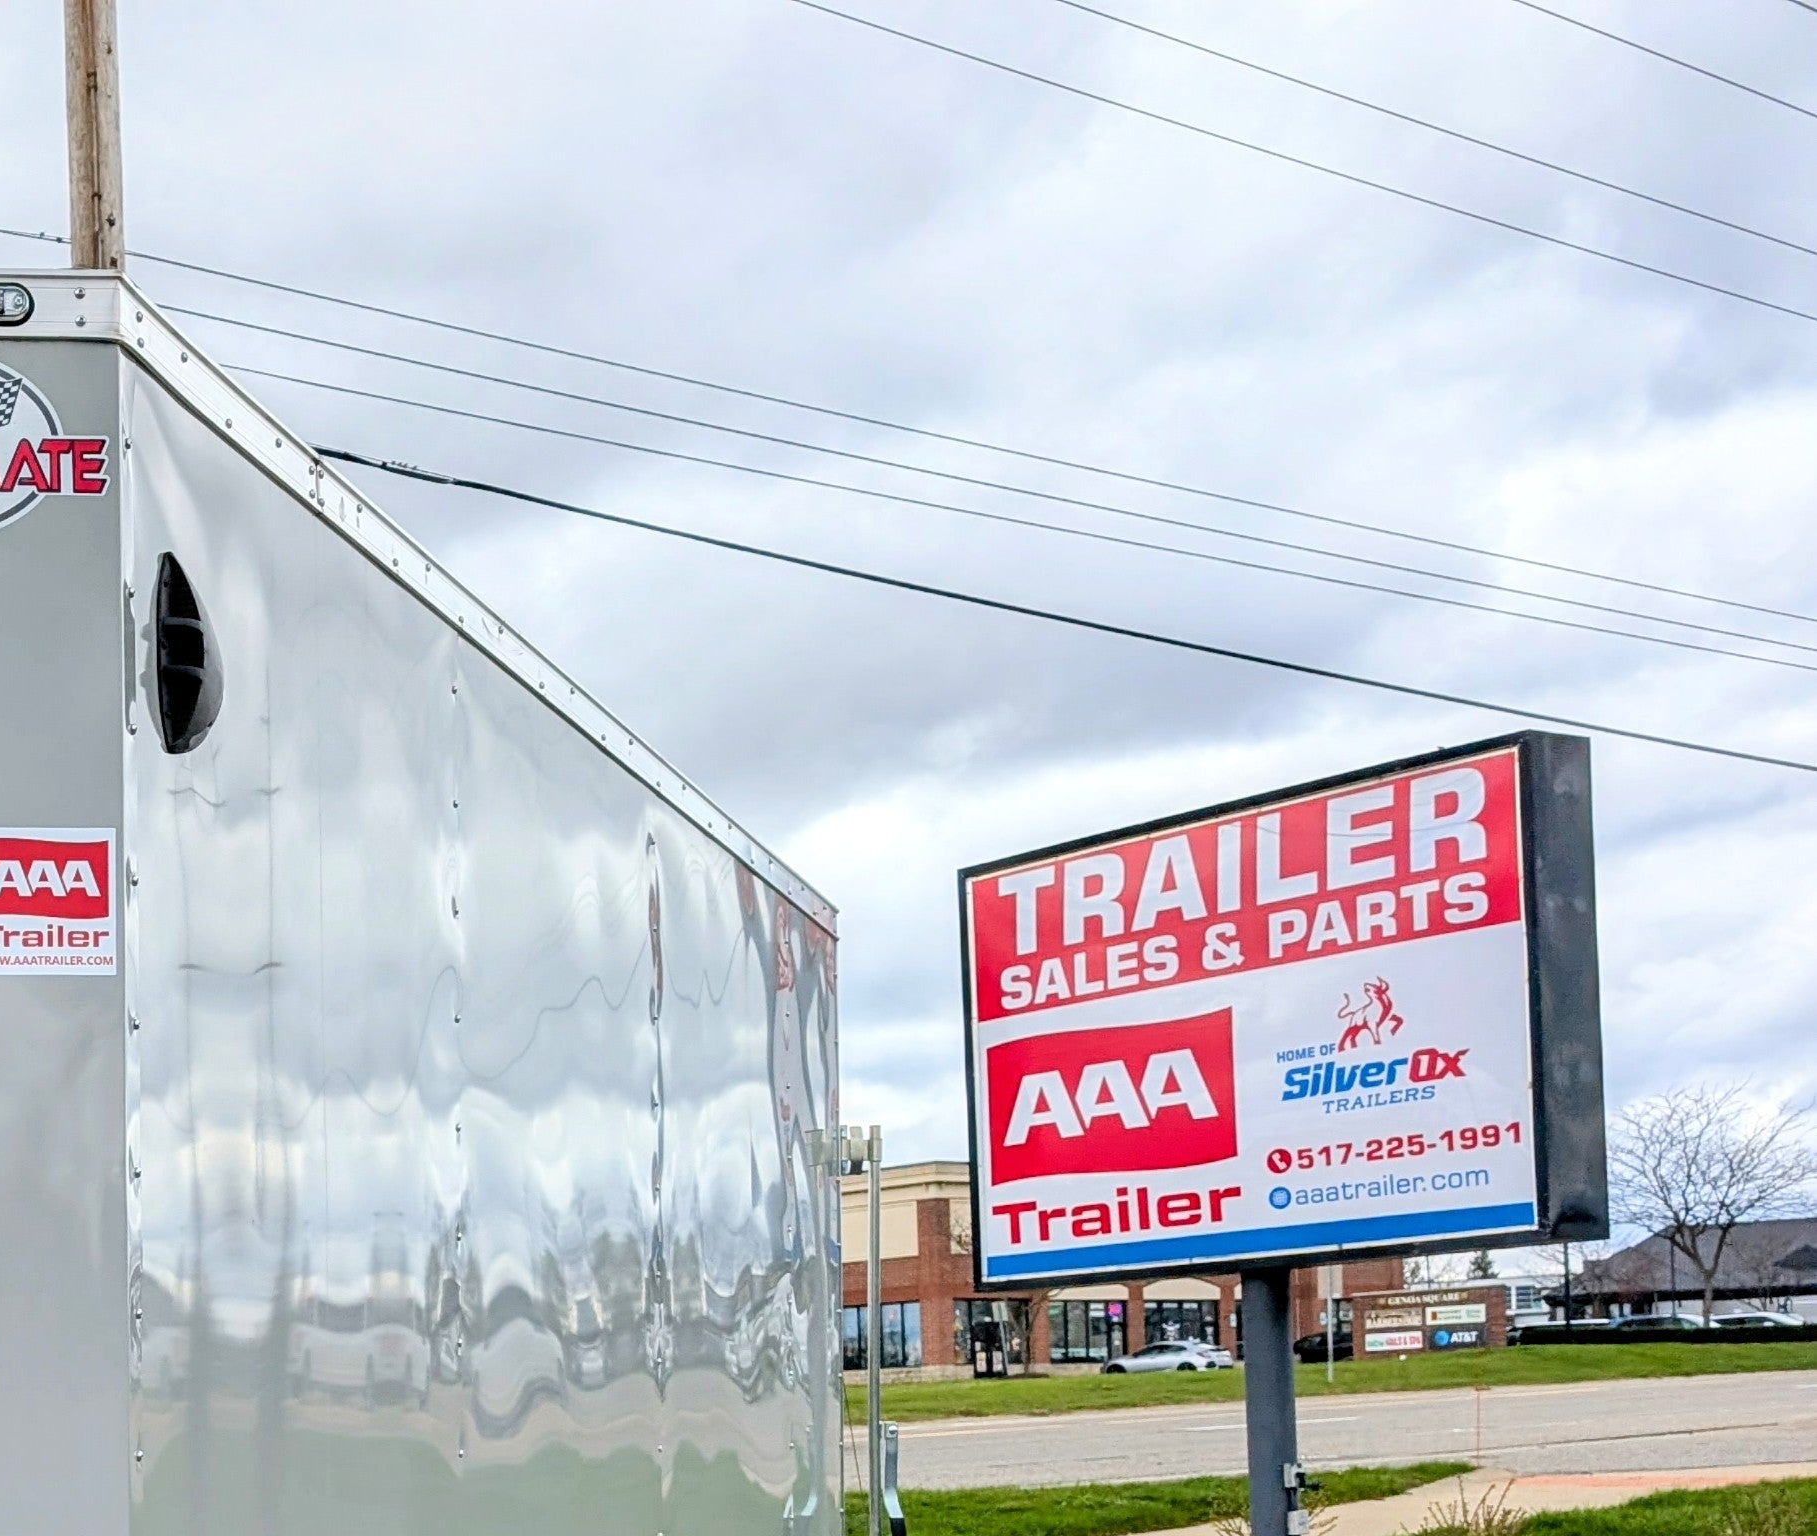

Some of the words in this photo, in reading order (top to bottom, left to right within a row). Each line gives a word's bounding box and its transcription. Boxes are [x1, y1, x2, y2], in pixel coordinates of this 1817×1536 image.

[998, 767, 1488, 956] TRAILER
[1000, 935, 1180, 1011] SALES
[1202, 922, 1245, 971] &
[1268, 872, 1489, 960] PARTS
[1277, 1046, 1316, 1063] HOME
[1319, 1043, 1336, 1056] OF
[1003, 1048, 1219, 1147] AAA
[1323, 1085, 1436, 1114] TRAILERS
[1297, 1121, 1521, 1170] 517-225-1991
[1295, 1168, 1490, 1206] aaatrailer.com
[992, 1185, 1242, 1245] Trailer
[1450, 1331, 1478, 1344] AT&T
